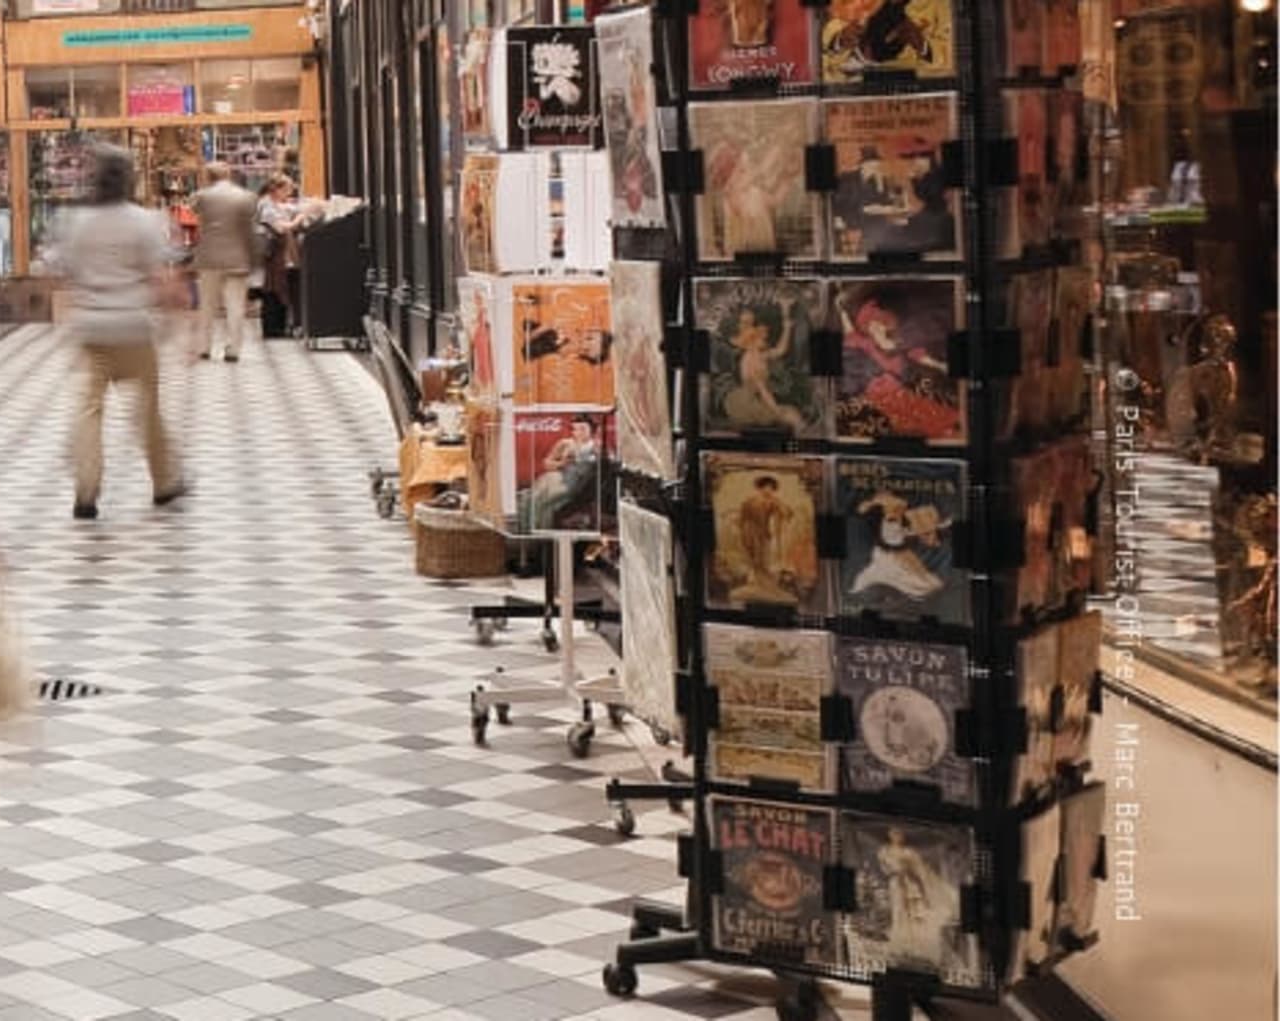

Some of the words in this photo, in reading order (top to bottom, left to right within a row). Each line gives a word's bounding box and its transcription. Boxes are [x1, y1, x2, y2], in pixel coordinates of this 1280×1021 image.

[852, 645, 946, 672] SAVON
[734, 804, 808, 823] SAVON
[720, 820, 750, 847] LE
[759, 822, 825, 857] CHAT
